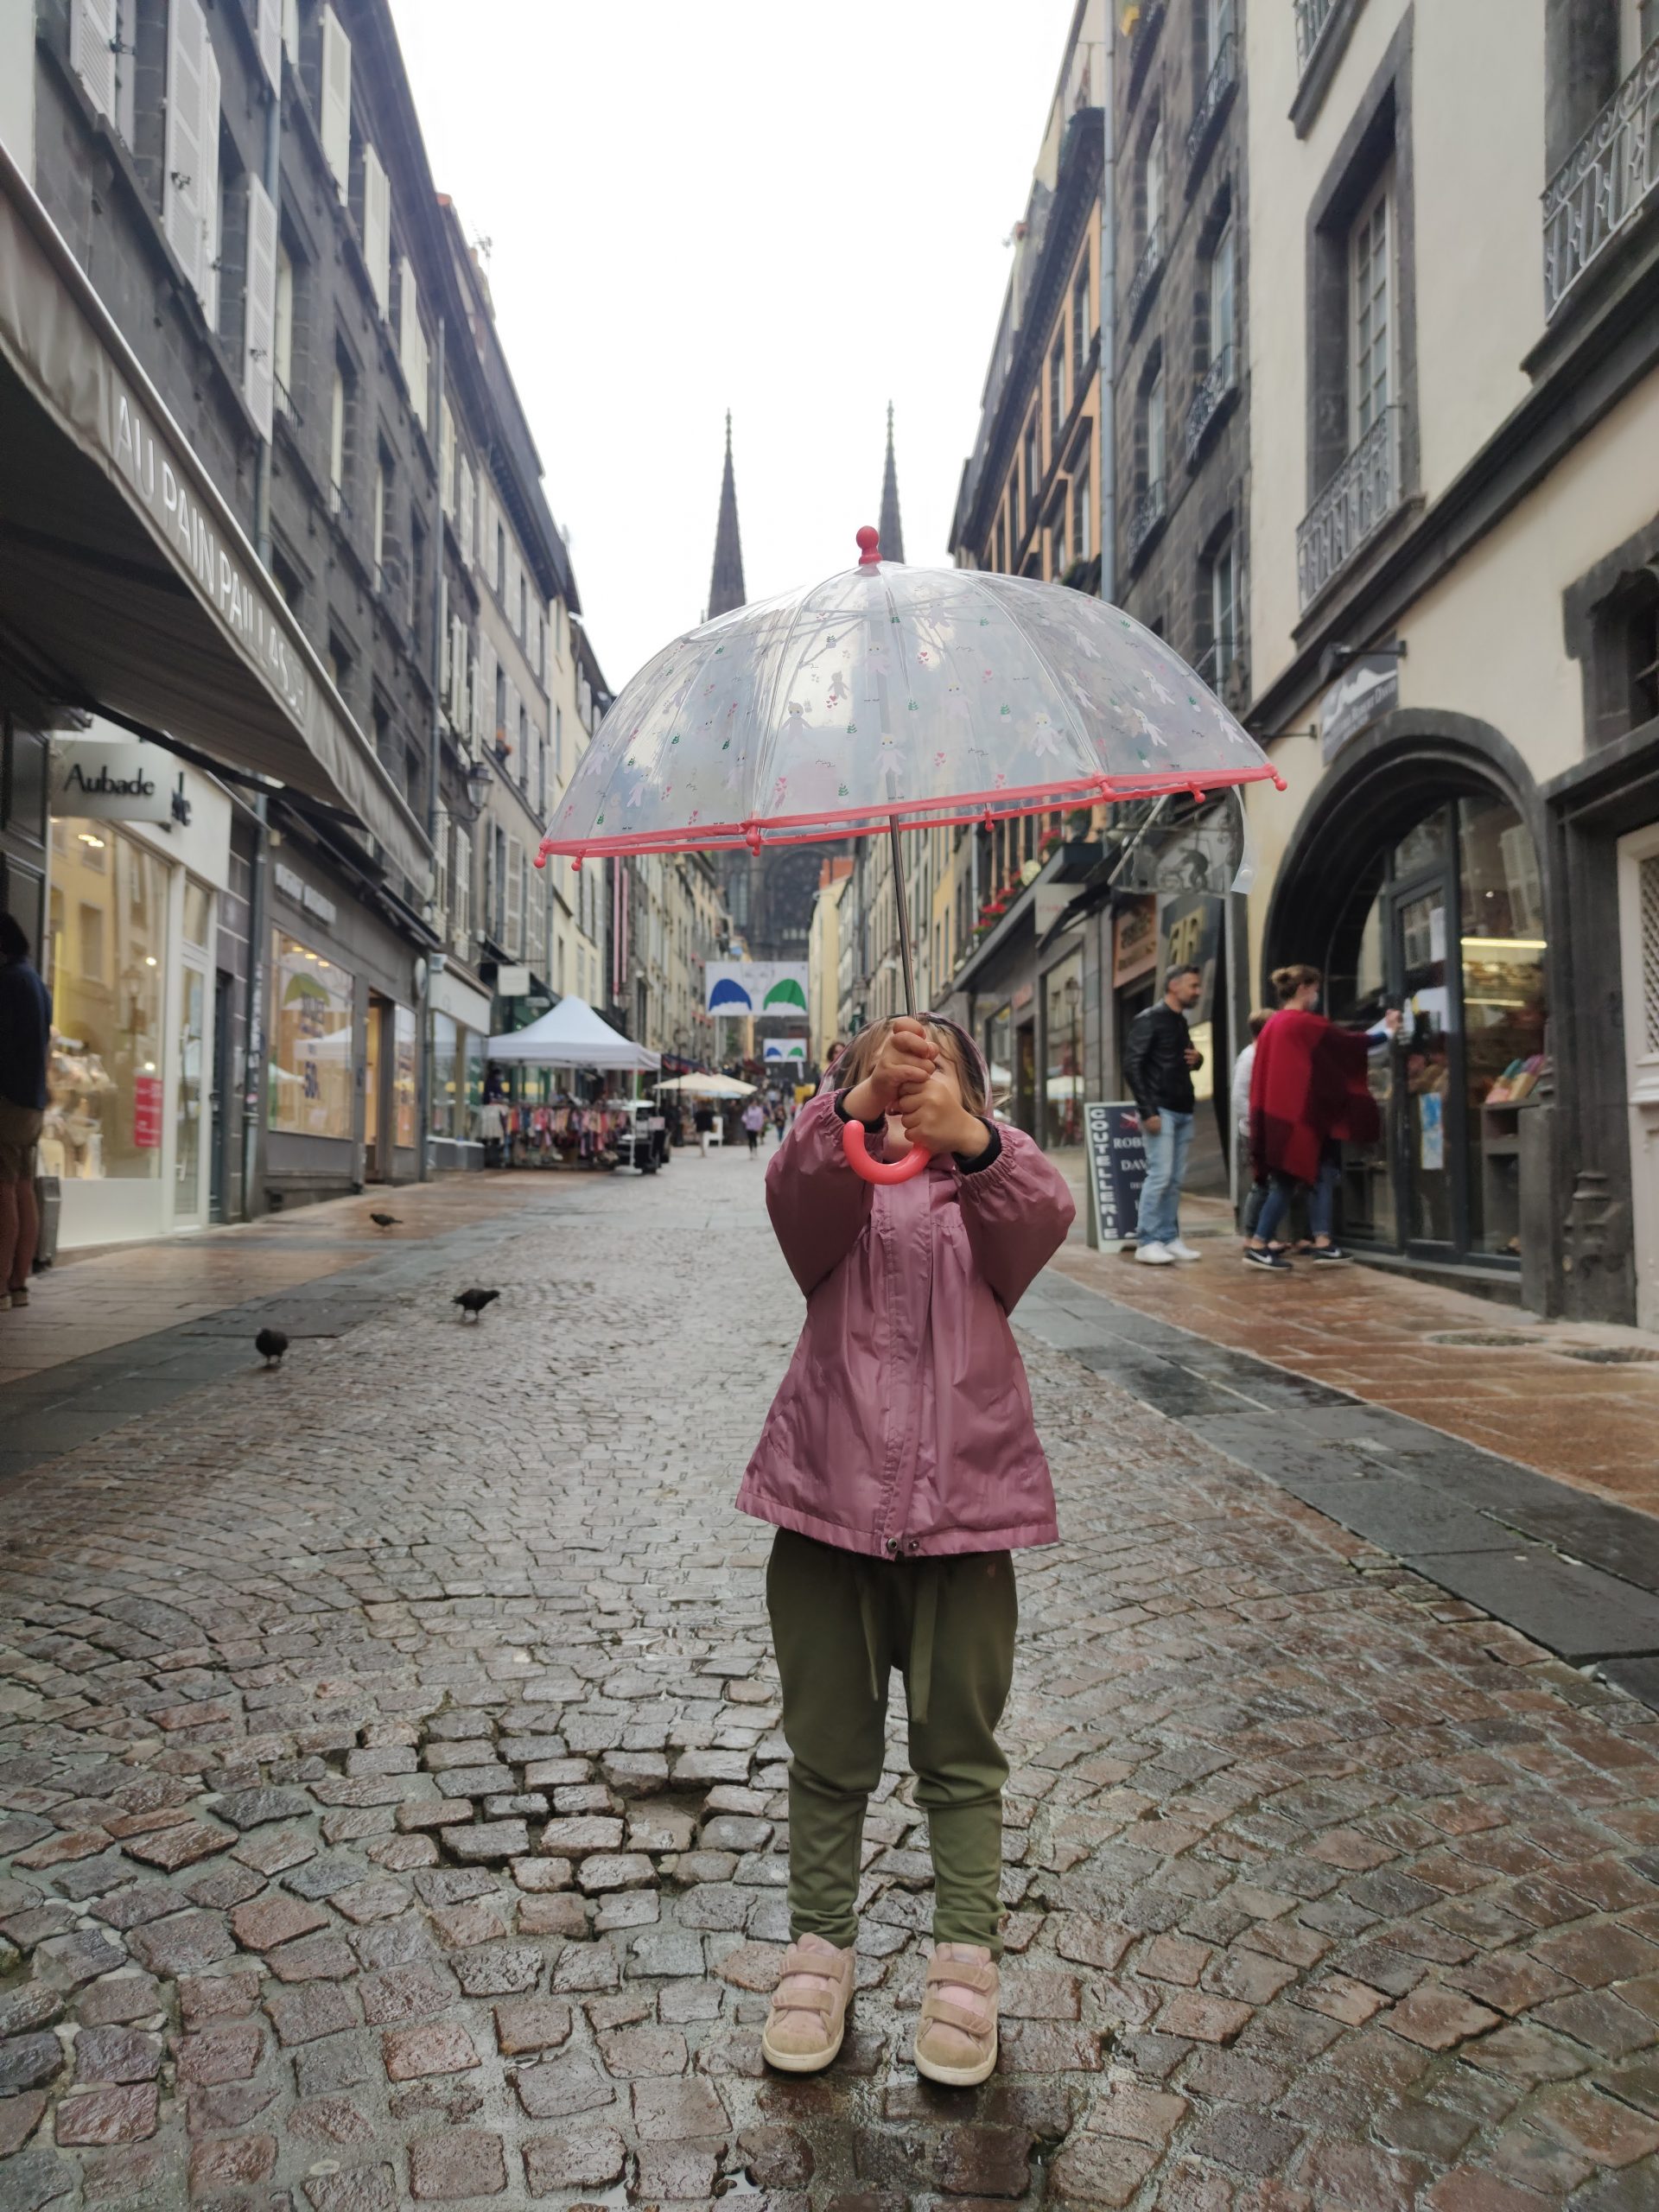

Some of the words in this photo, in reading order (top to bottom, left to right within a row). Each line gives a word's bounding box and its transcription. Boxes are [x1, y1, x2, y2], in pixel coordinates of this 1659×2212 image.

[113, 396, 155, 505] AU
[162, 460, 214, 595] PAIN
[63, 763, 156, 796] Aubade
[1090, 1109, 1119, 1240] COUTELLERIE
